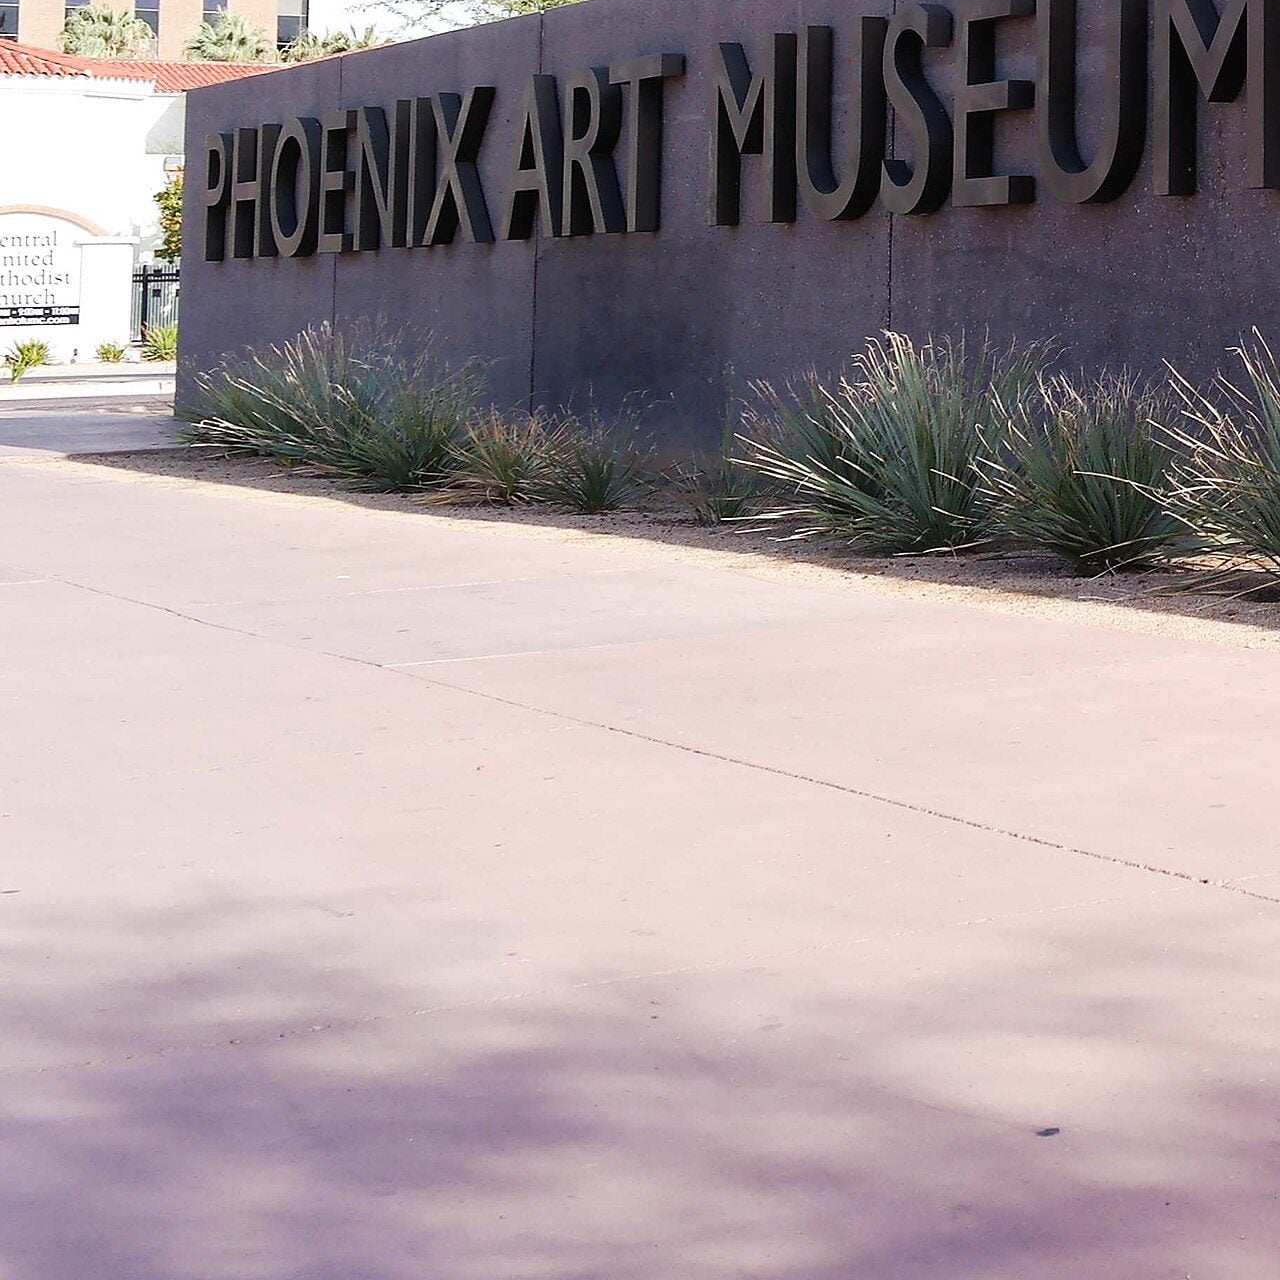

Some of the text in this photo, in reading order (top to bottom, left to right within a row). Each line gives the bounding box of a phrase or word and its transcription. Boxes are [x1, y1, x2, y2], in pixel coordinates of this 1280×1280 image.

[204, 85, 495, 262] PHOENIX
[503, 52, 686, 240] ART
[0, 230, 57, 247] entral
[3, 250, 53, 267] nited
[0, 269, 70, 286] thodist
